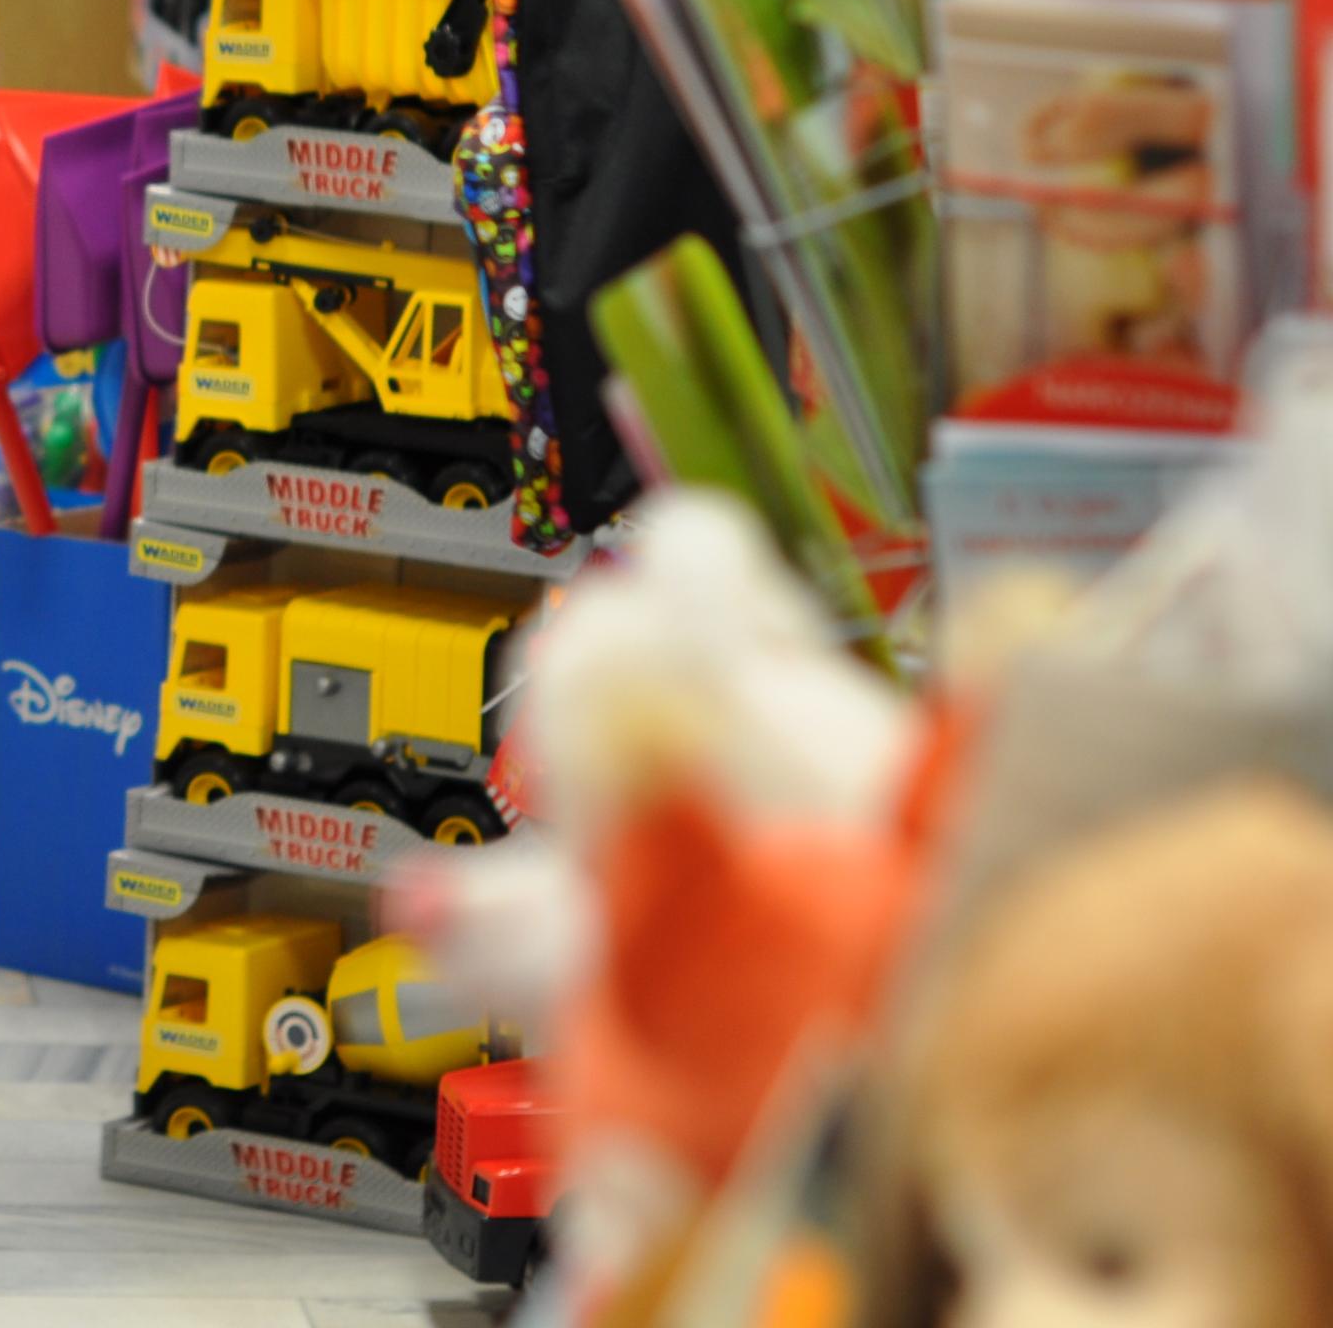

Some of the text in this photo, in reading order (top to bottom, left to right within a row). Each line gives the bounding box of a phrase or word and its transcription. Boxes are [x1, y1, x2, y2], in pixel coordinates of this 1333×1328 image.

[218, 41, 270, 58] WADER
[287, 138, 397, 177] MIDDLE
[300, 171, 383, 200] TRUCK
[155, 208, 210, 231] WADER
[195, 377, 250, 396] WADER
[266, 473, 384, 515] MIDDLE
[281, 506, 370, 538] TRUCK
[142, 543, 199, 567] WADER
[2, 660, 142, 757] Disney
[178, 695, 235, 717] WADER
[255, 806, 379, 850] MIDDLE
[270, 838, 364, 872] TRUCK
[116, 876, 177, 901] WADER
[159, 1028, 218, 1052] WADER
[230, 1142, 358, 1188] MIDDLE
[245, 1174, 343, 1209] TRUCK
